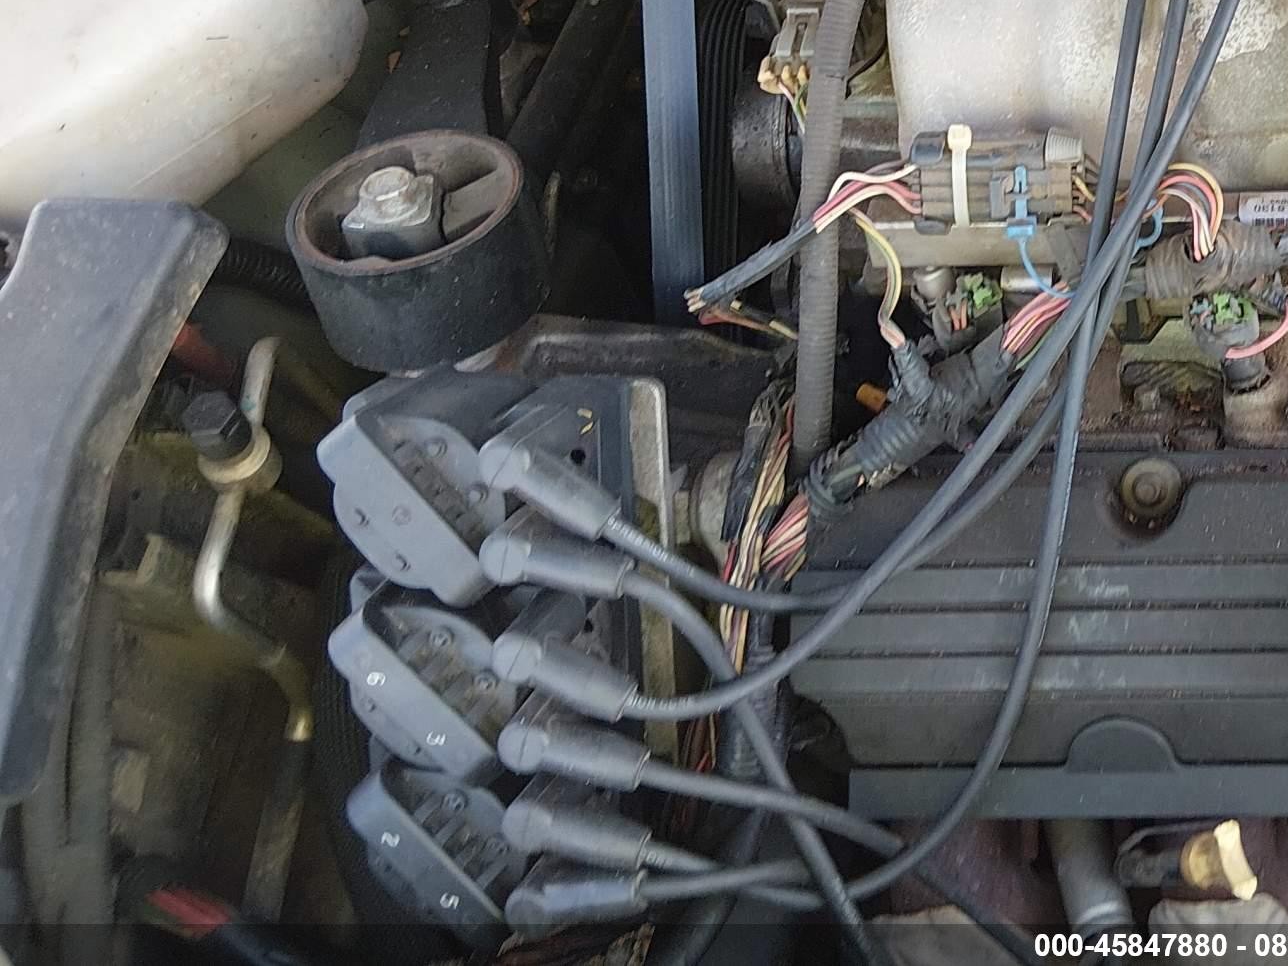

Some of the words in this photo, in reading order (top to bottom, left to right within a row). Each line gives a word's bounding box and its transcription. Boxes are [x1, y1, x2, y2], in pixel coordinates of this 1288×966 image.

[426, 731, 447, 746] 3
[381, 831, 401, 848] 2
[439, 892, 461, 910] 5
